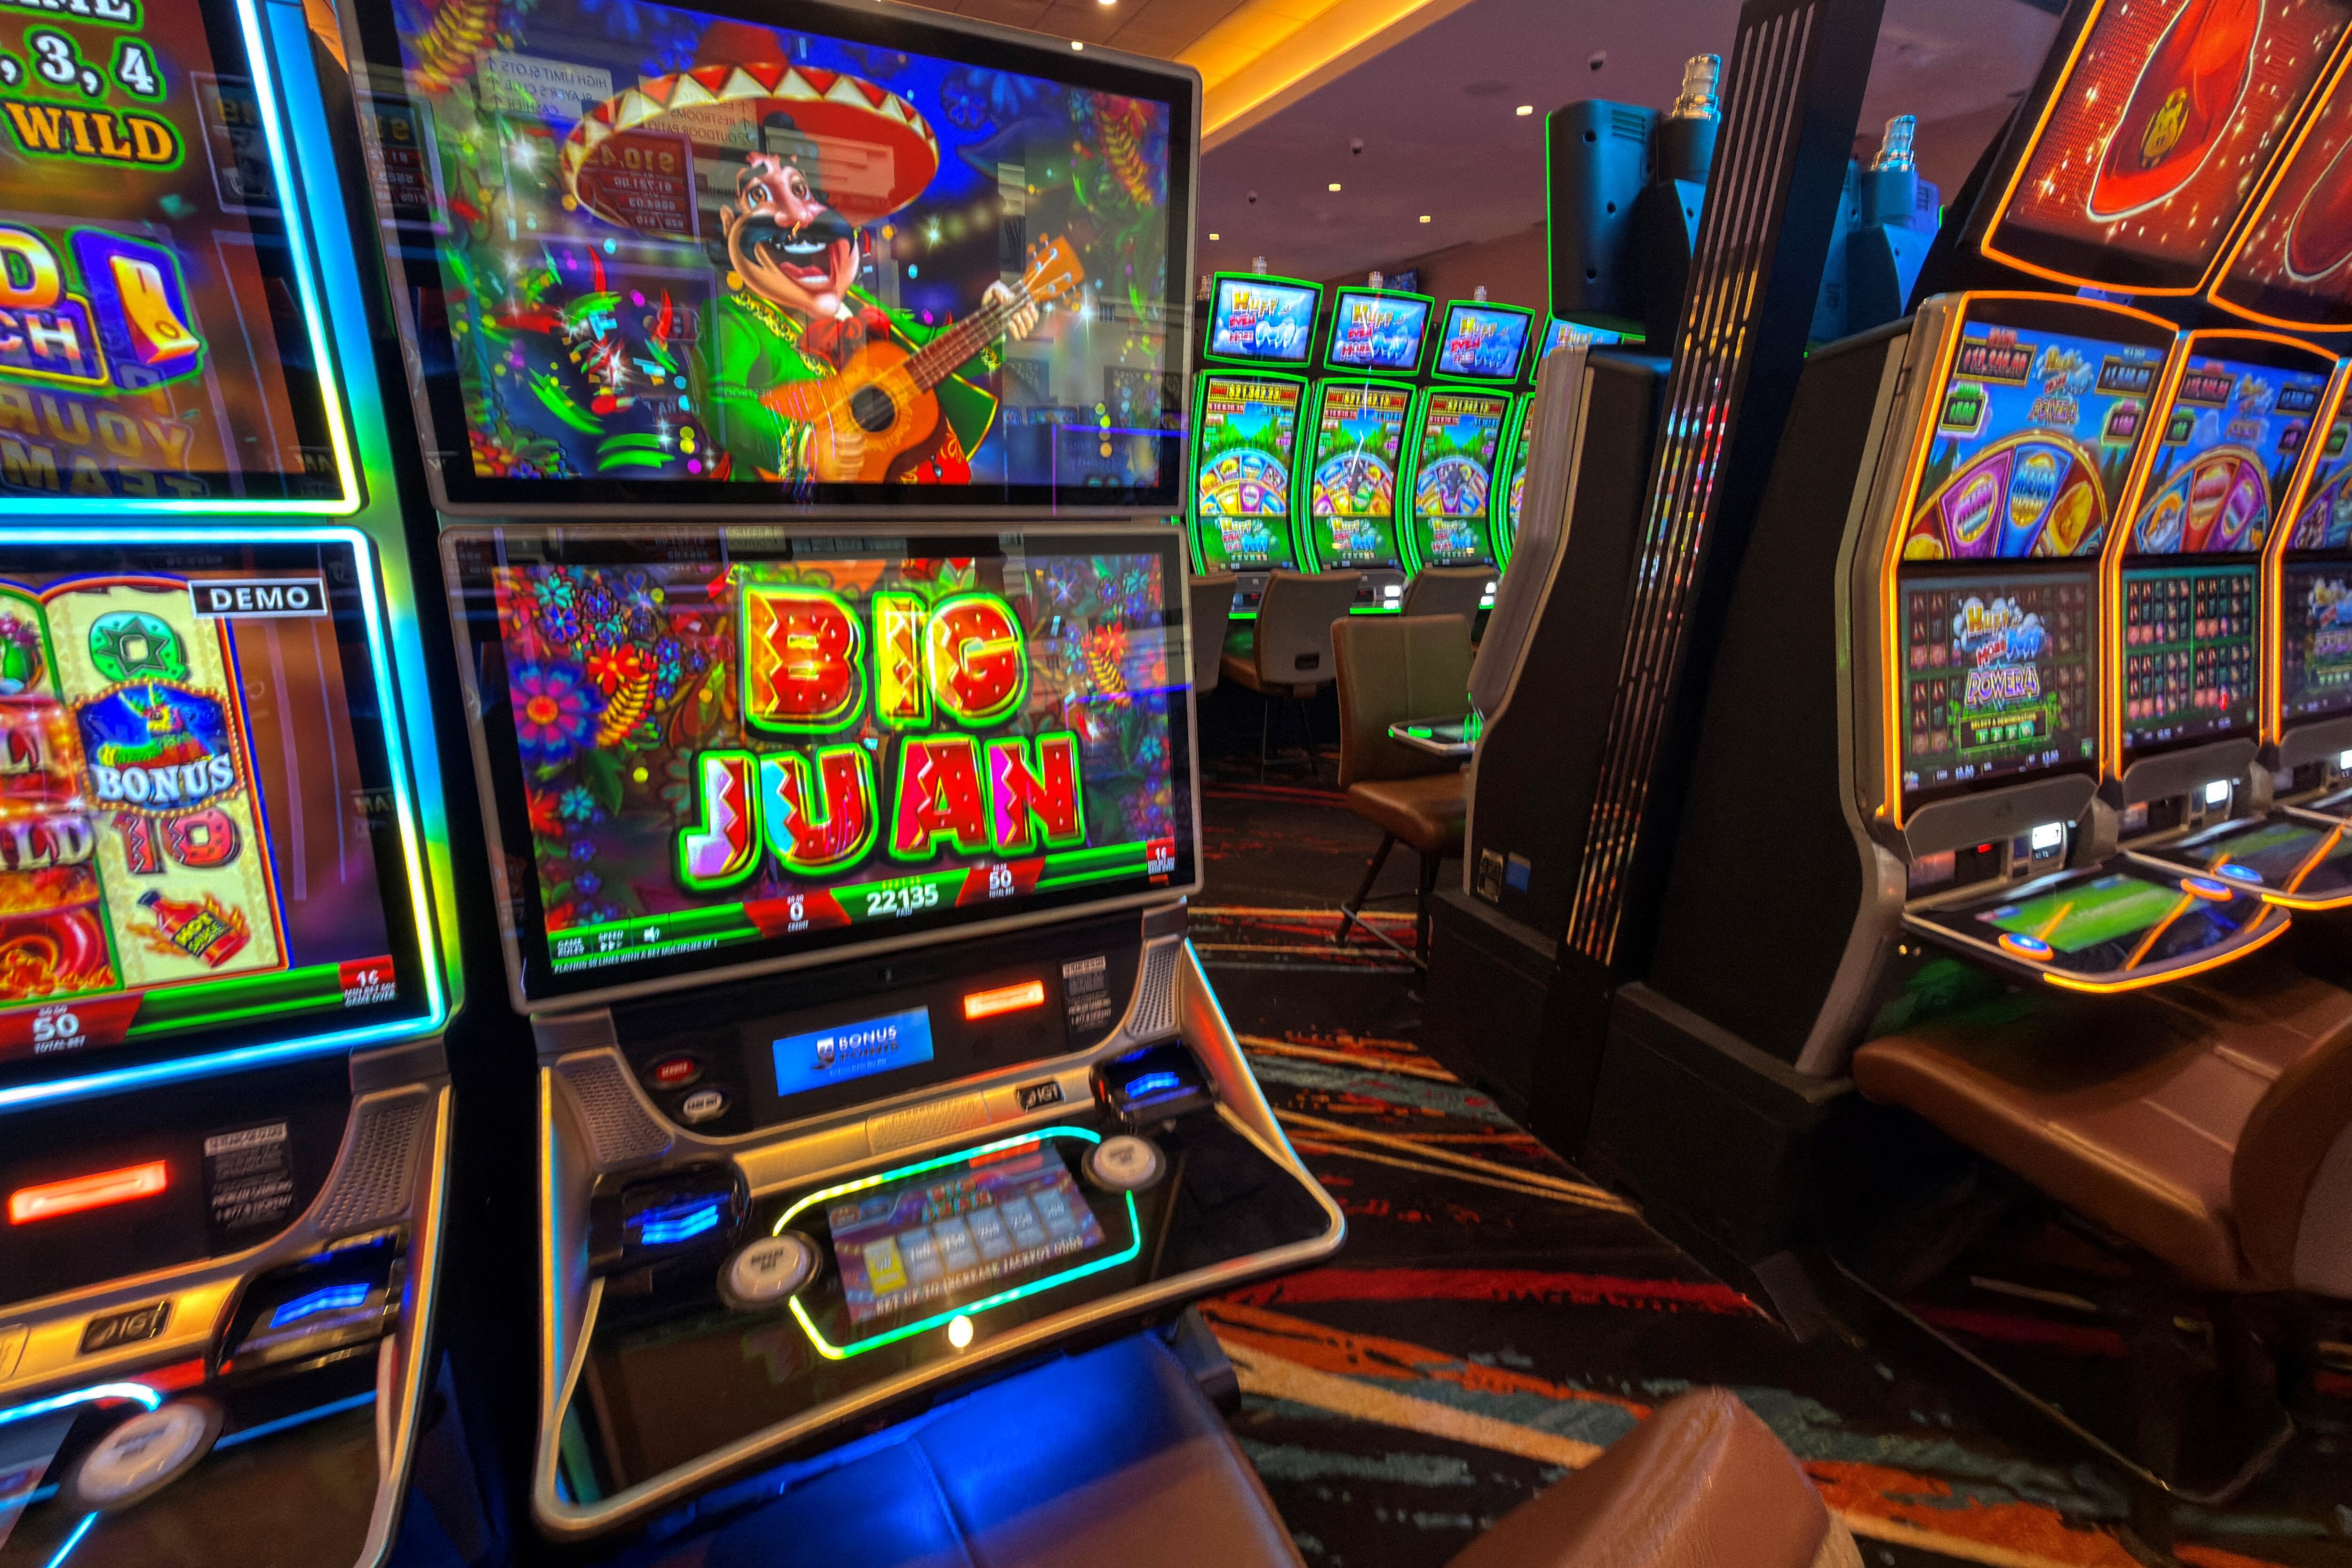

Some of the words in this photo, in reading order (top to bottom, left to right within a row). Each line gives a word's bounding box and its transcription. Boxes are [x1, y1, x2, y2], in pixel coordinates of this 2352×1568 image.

[37, 35, 98, 94] 3,
[121, 47, 154, 93] 4
[6, 101, 173, 162] WILD
[210, 587, 310, 612] DEMO
[742, 583, 1029, 735] BIG
[89, 753, 235, 804] BONUS
[678, 730, 1086, 891] JUAN
[989, 870, 1012, 890] 50
[790, 902, 804, 922] 0
[866, 882, 939, 917] 22135
[32, 1013, 79, 1043] 50
[839, 1024, 897, 1052] BONUS
